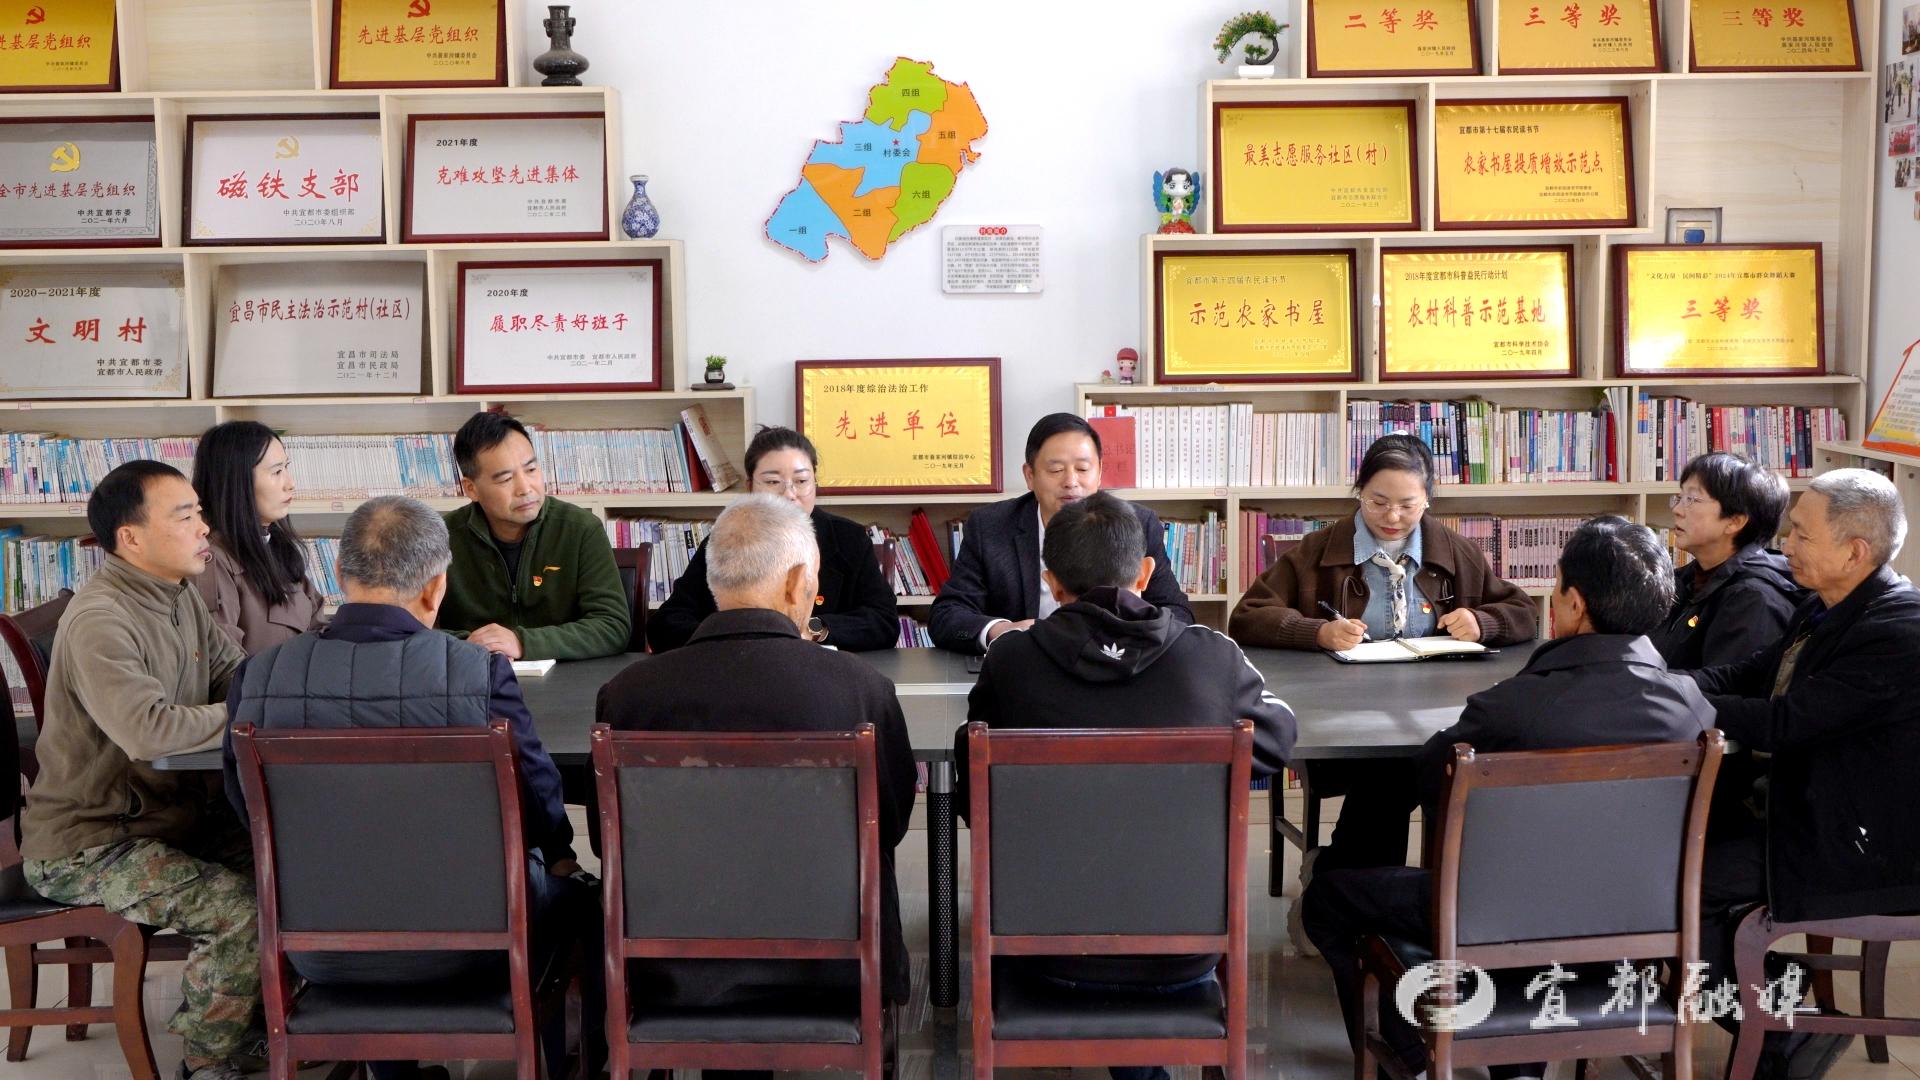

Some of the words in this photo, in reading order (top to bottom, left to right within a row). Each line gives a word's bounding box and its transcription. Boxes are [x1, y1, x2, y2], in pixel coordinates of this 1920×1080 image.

[1524, 2, 1622, 29] 三等奖
[1721, 7, 1805, 28] 三等奖
[1344, 8, 1438, 34] 二等奖
[358, 24, 479, 45] 先进基层党组织
[901, 88, 921, 97] 四组
[938, 130, 956, 140] 五组
[1459, 125, 1540, 135] 宜都市第十七届农民读书节
[436, 138, 478, 147] 2021年度
[854, 143, 872, 152] 三组
[883, 148, 911, 158] 村委会
[1464, 150, 1603, 177] 农家书屋提质增效示范点
[436, 163, 580, 186] 克难攻坚先进集体
[0, 181, 136, 199] 全市先进基层党组织
[216, 168, 360, 203] 磁铁支部
[912, 190, 931, 199] 六组
[77, 208, 132, 217] 中共宜都市委
[283, 208, 355, 217] 中共宜都市委组织部
[853, 209, 871, 218] 二组
[788, 226, 807, 235] 一组
[487, 288, 529, 297] 2020年度
[1190, 298, 1325, 328] 示范农家书屋
[1408, 296, 1546, 328] 农村科普示范基地
[1681, 296, 1763, 322] 三等奖
[490, 312, 629, 333] 履职尽责好班子
[25, 317, 148, 344] 文明村
[336, 350, 399, 359] 宜昌市司法局
[97, 358, 163, 367] 中共宜都市委
[336, 361, 399, 370] 宜昌市民政局
[97, 368, 163, 377] 宜都市人民政府
[823, 383, 929, 393] 2018年度综治法治工作
[835, 409, 960, 441] 先进单位
